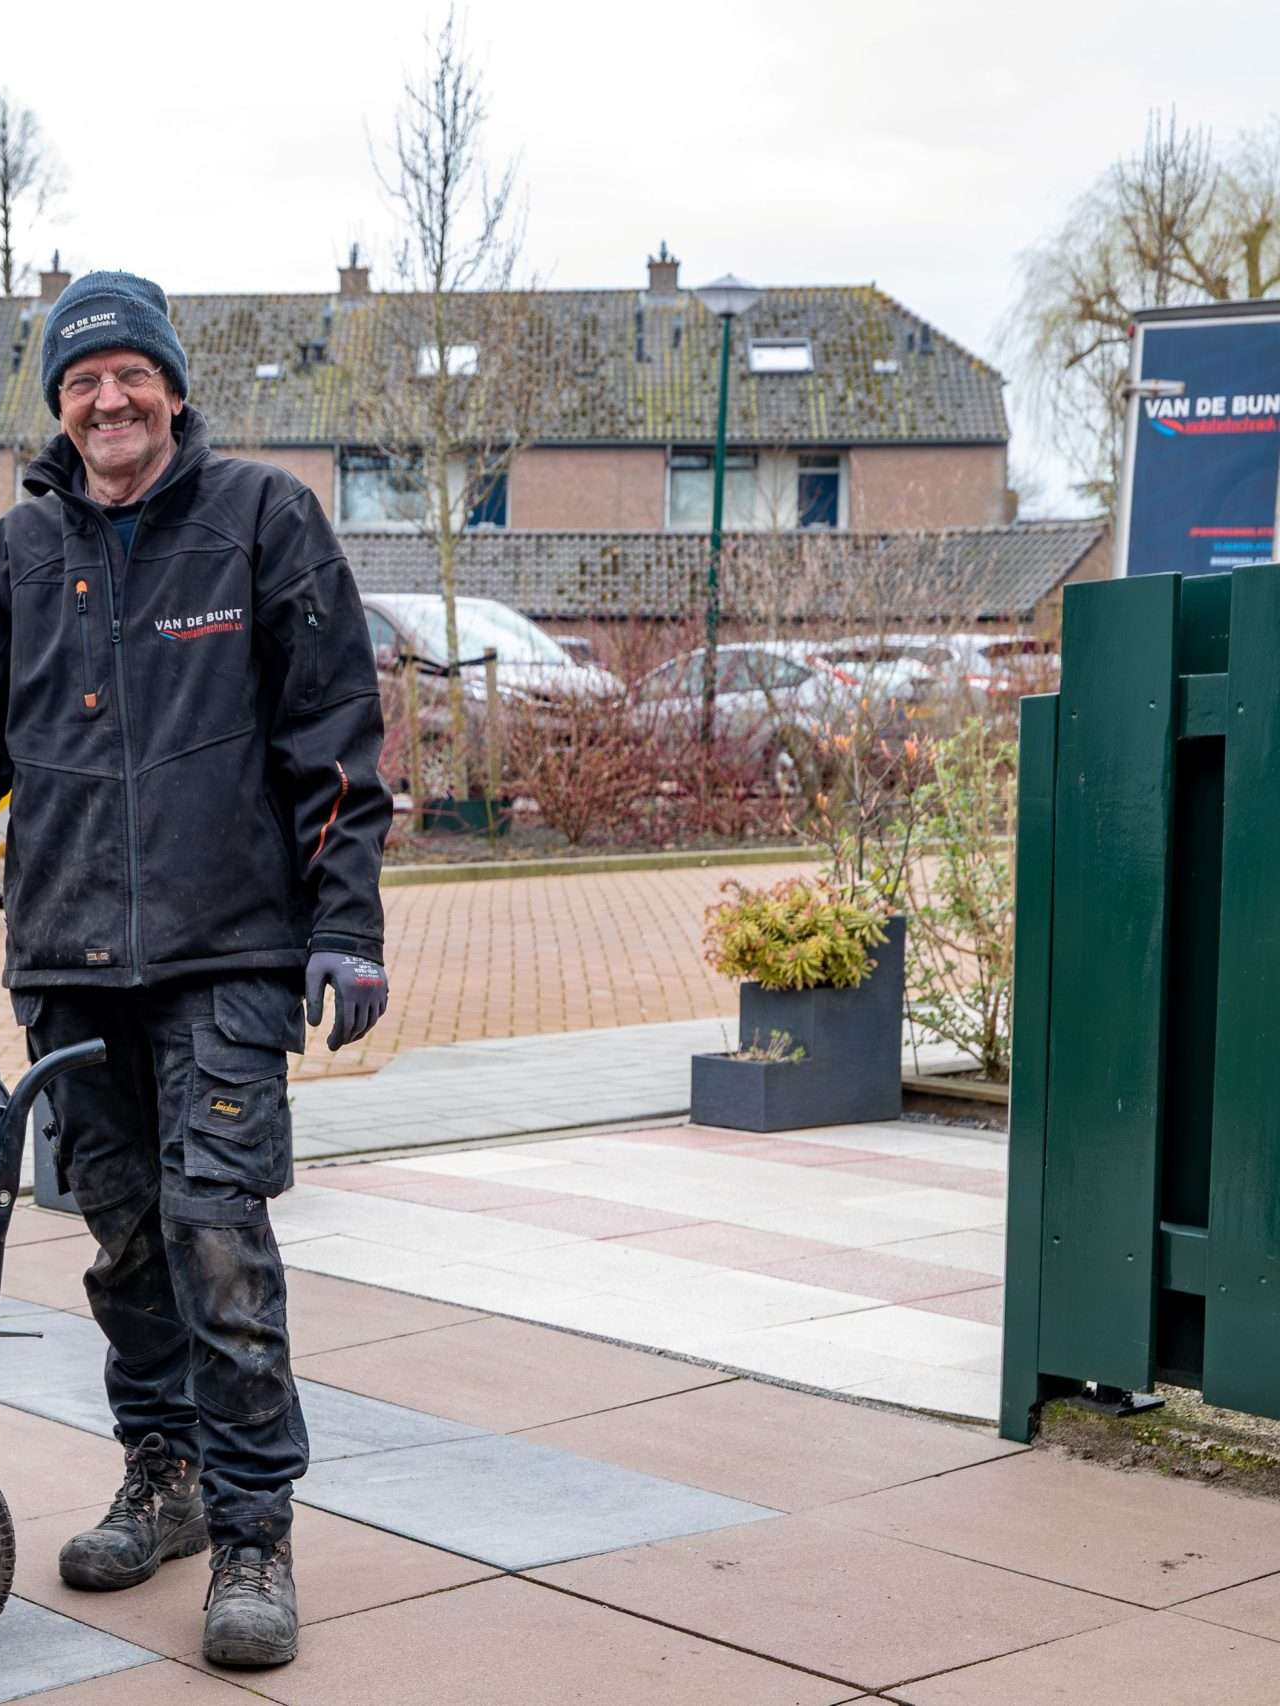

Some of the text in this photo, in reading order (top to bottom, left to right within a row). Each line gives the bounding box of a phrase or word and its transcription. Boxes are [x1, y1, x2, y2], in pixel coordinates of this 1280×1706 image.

[61, 322, 76, 337] VAN
[77, 317, 89, 328] DE
[90, 312, 116, 323] BUNT
[1144, 397, 1191, 419] VAN
[1195, 396, 1227, 417] DE
[155, 608, 243, 631] VAN DE BUNT
